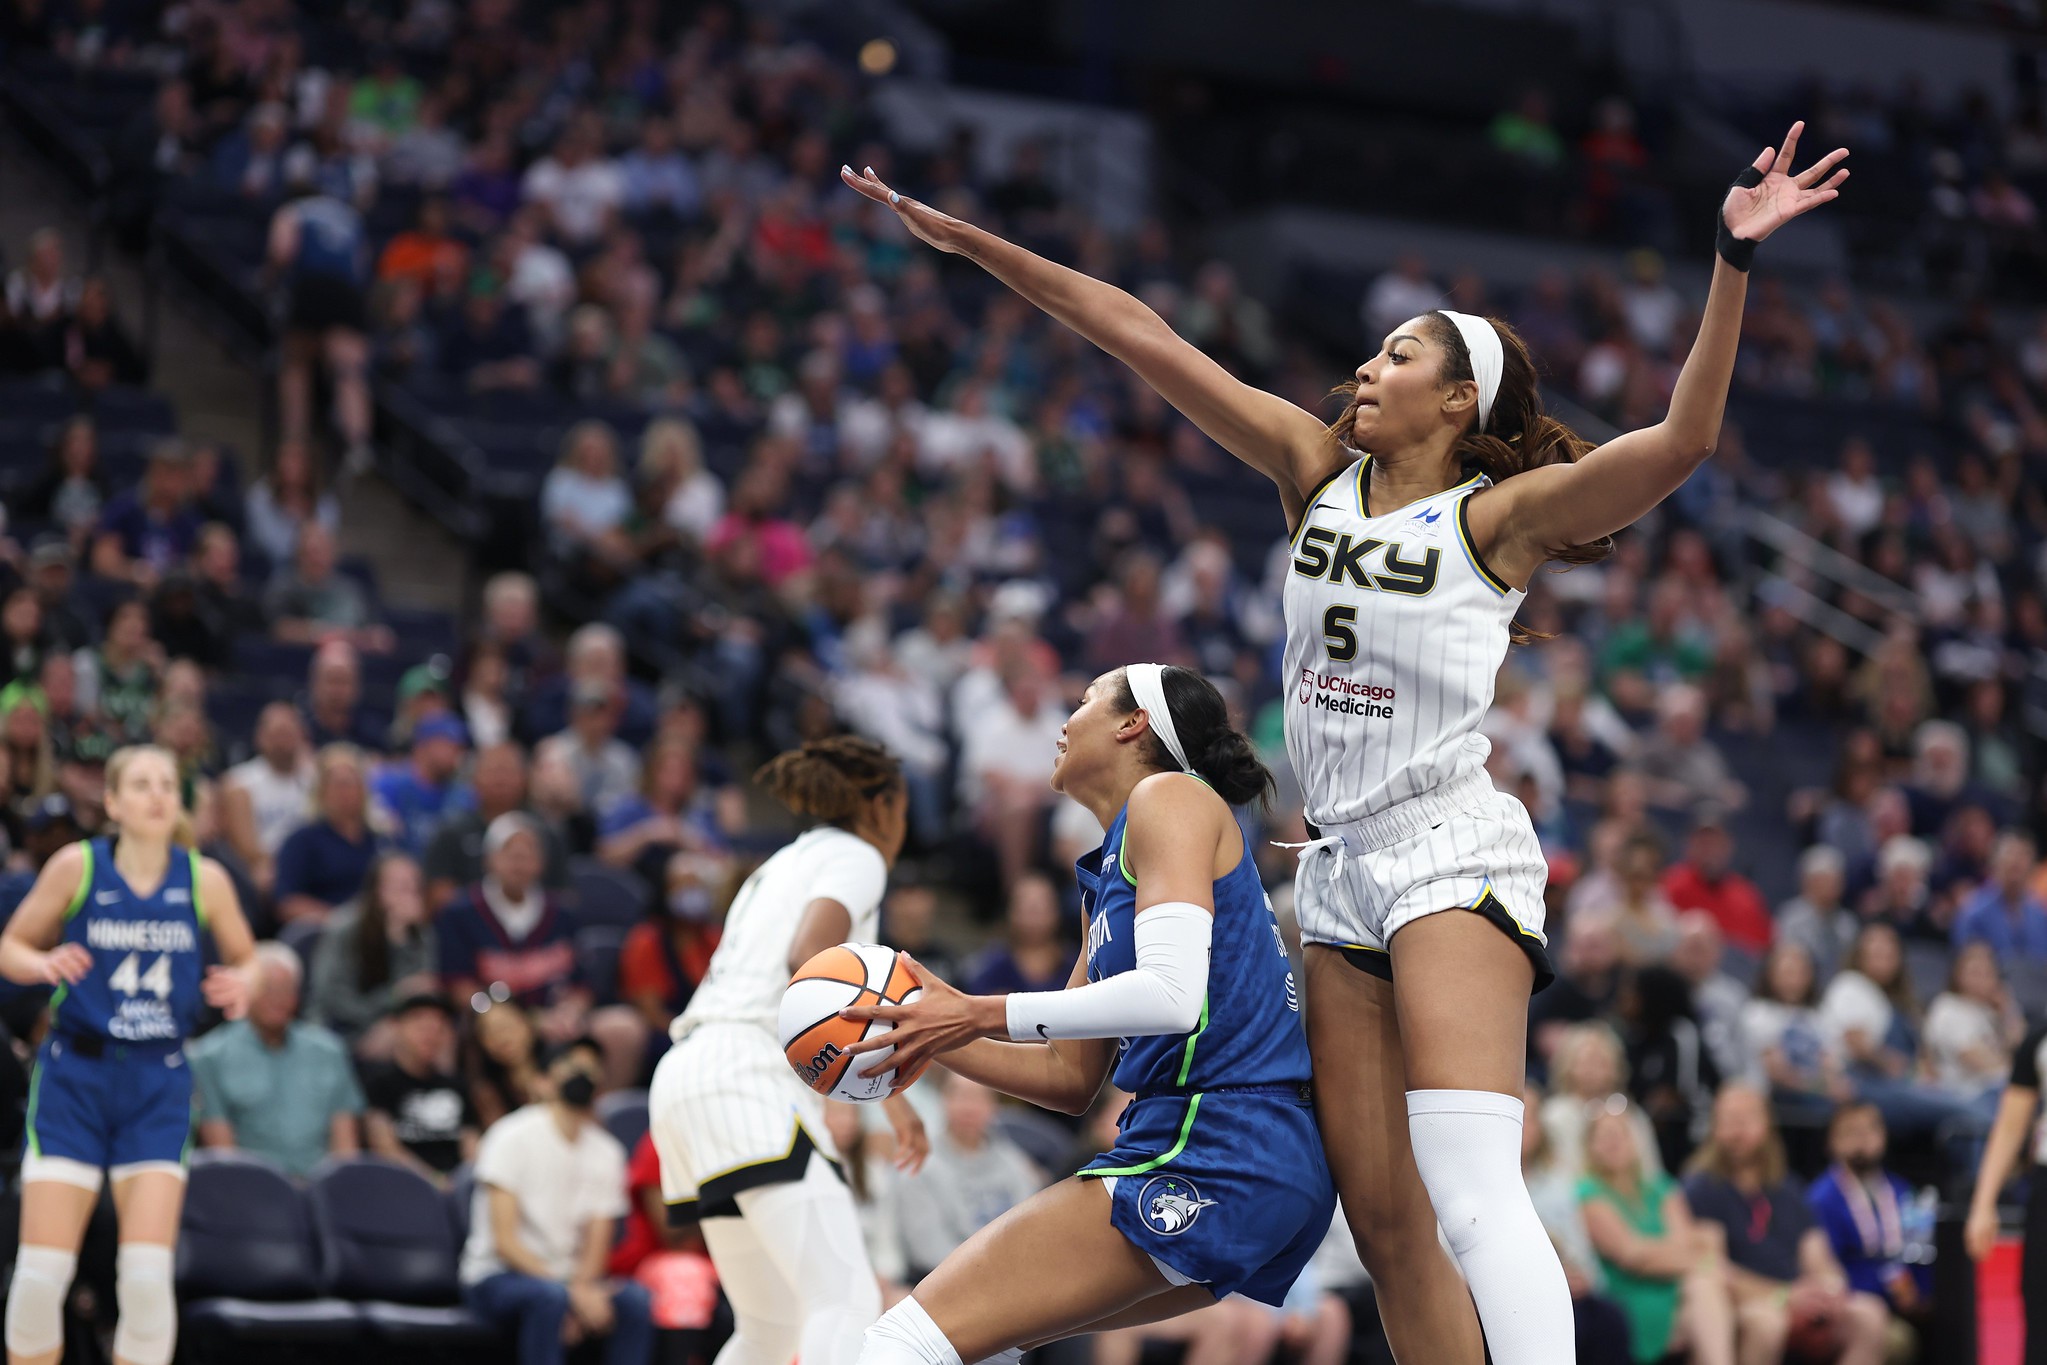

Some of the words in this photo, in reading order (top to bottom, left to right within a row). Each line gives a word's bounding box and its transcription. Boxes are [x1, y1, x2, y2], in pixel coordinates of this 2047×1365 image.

[1293, 525, 1443, 597] SKY
[1322, 604, 1359, 663] 5
[1315, 693, 1394, 719] Medicine
[1317, 674, 1395, 700] UChicago
[108, 951, 173, 999] 44
